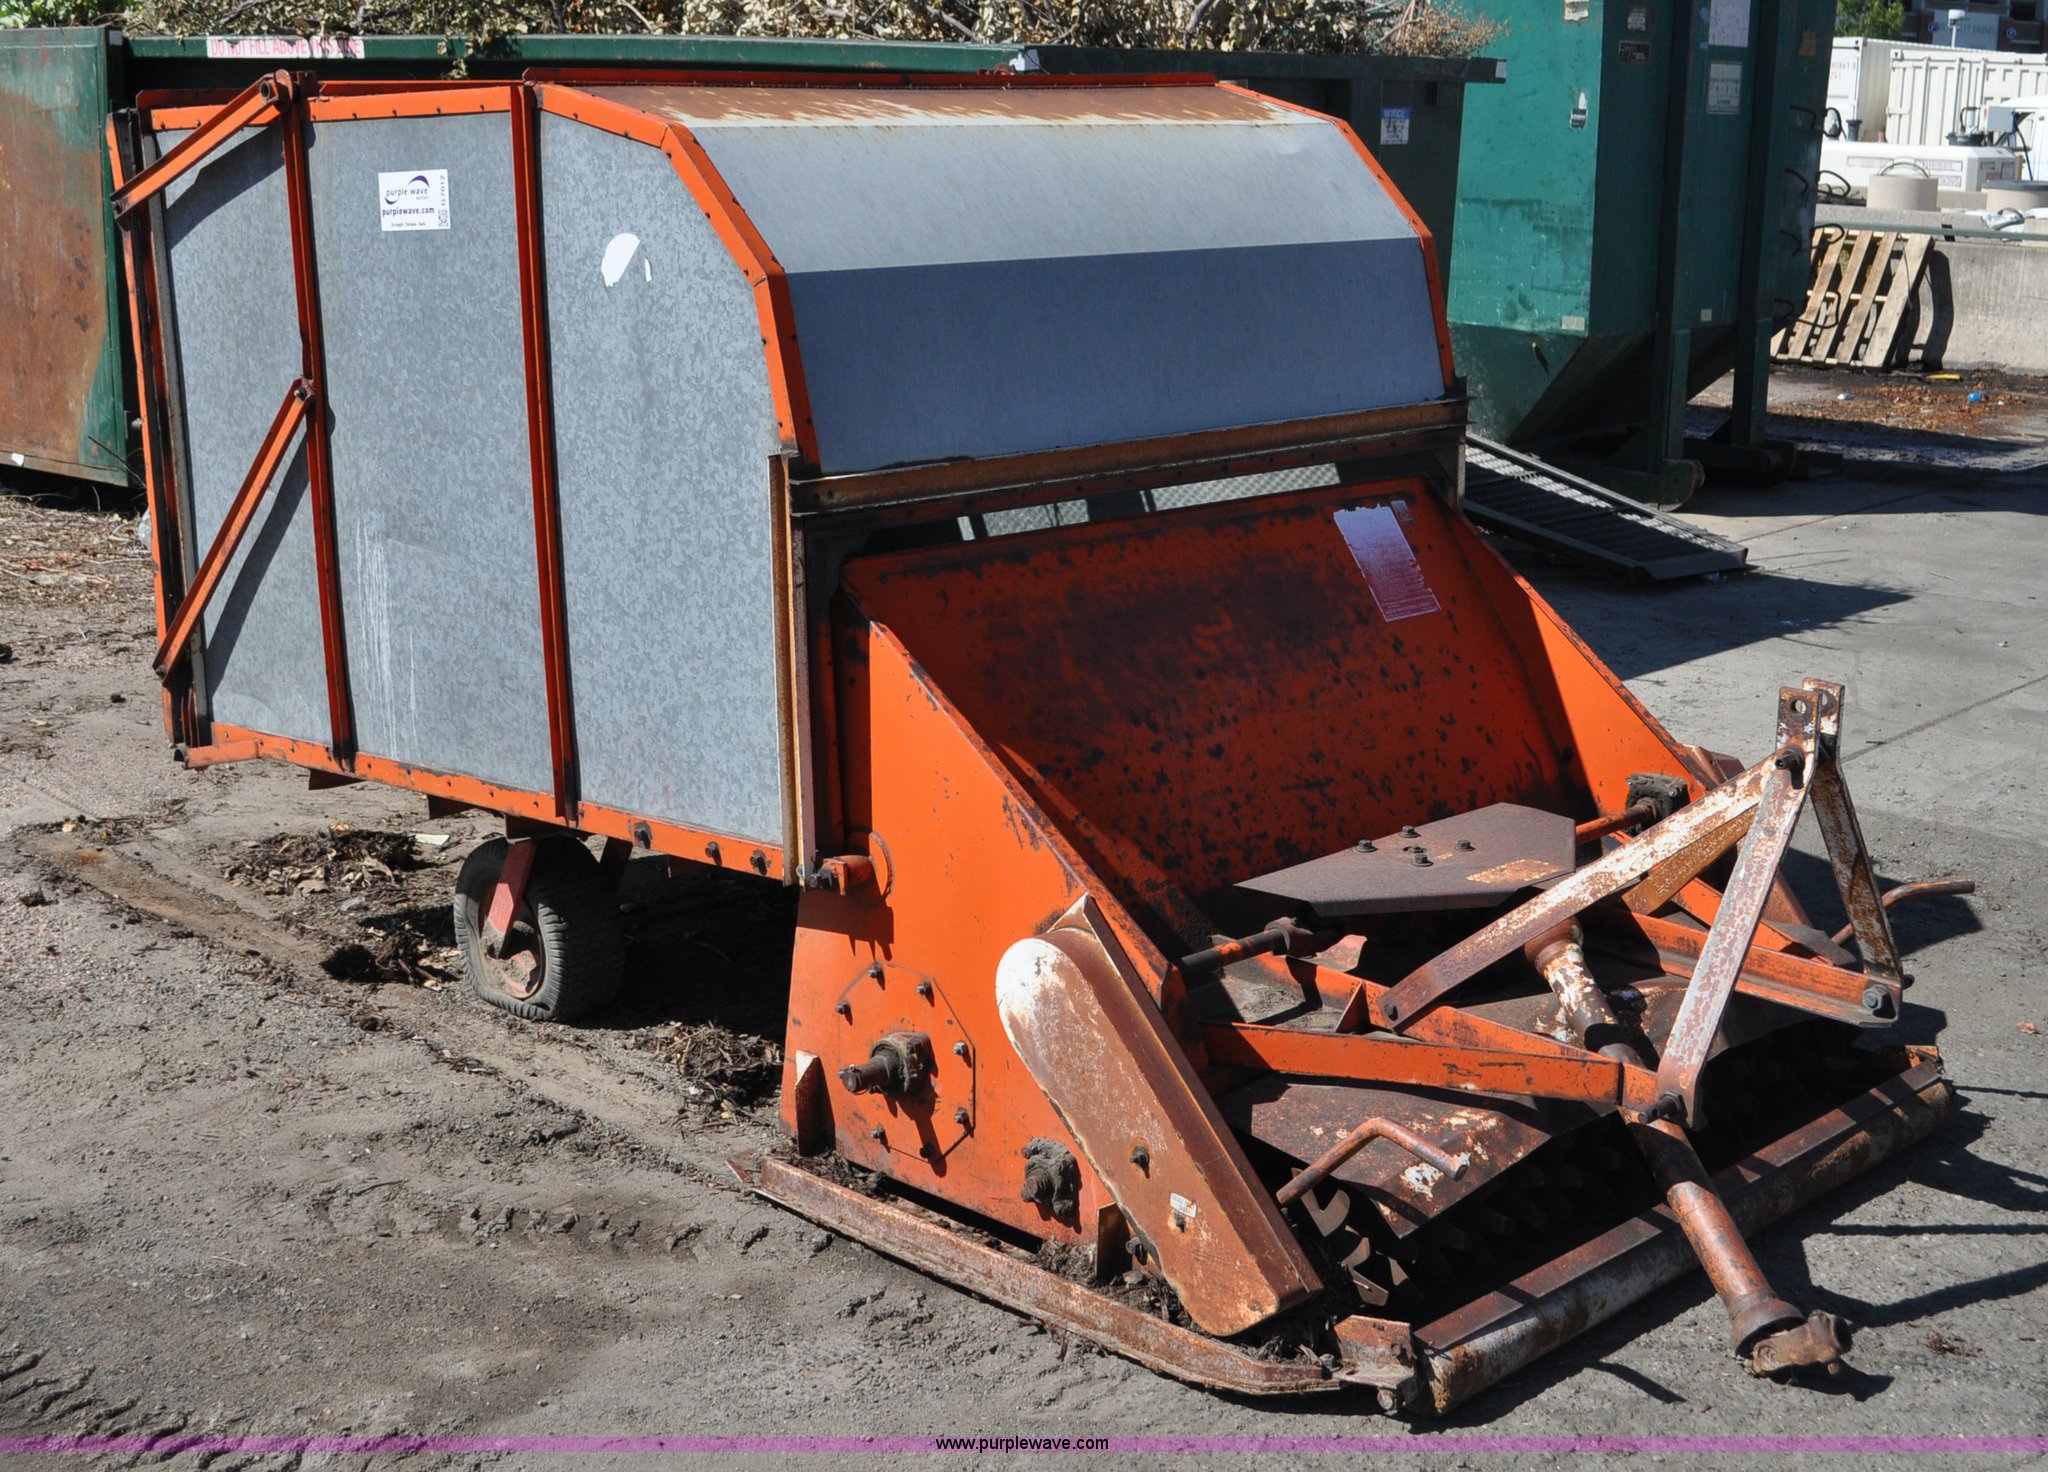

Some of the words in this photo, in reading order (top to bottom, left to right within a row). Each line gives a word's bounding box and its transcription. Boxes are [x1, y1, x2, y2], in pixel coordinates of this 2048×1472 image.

[211, 39, 225, 56] DO
[229, 39, 246, 56] NOT
[250, 39, 271, 55] FILL
[273, 38, 308, 55] ABOVE
[386, 187, 408, 197] purple
[382, 207, 435, 217] purplewave.com
